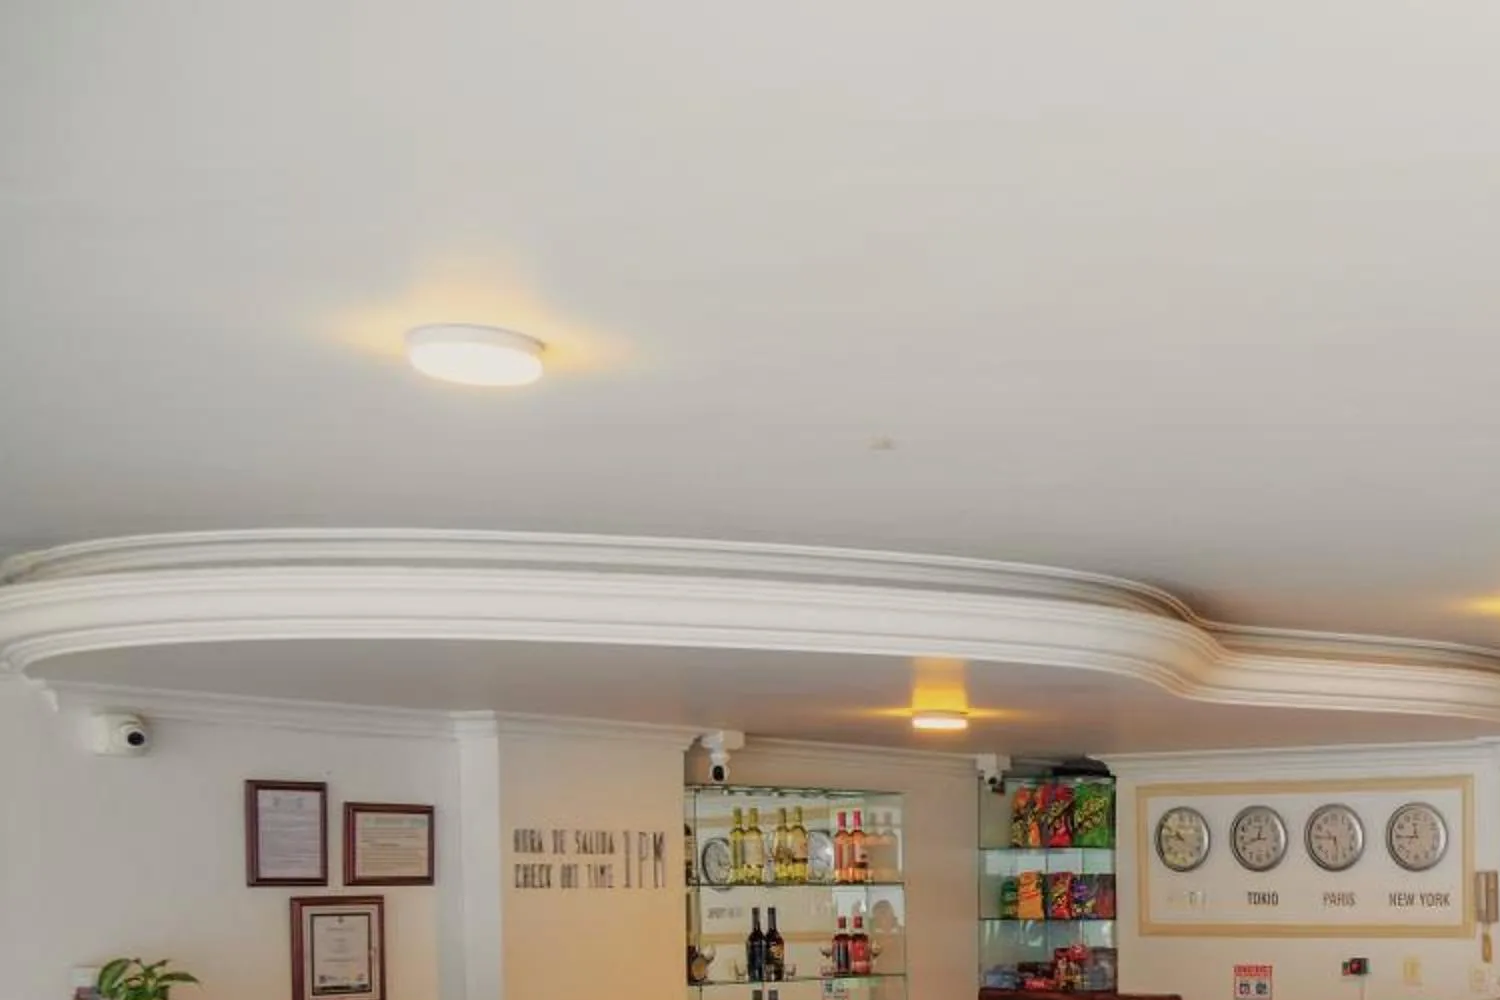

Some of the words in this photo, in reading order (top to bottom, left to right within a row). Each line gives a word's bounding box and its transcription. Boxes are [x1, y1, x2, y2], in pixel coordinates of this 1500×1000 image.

[1247, 891, 1279, 906] TOKIO
[1322, 891, 1356, 907] PARIS
[1388, 891, 1415, 907] NEW
[1419, 891, 1451, 907] YORK
